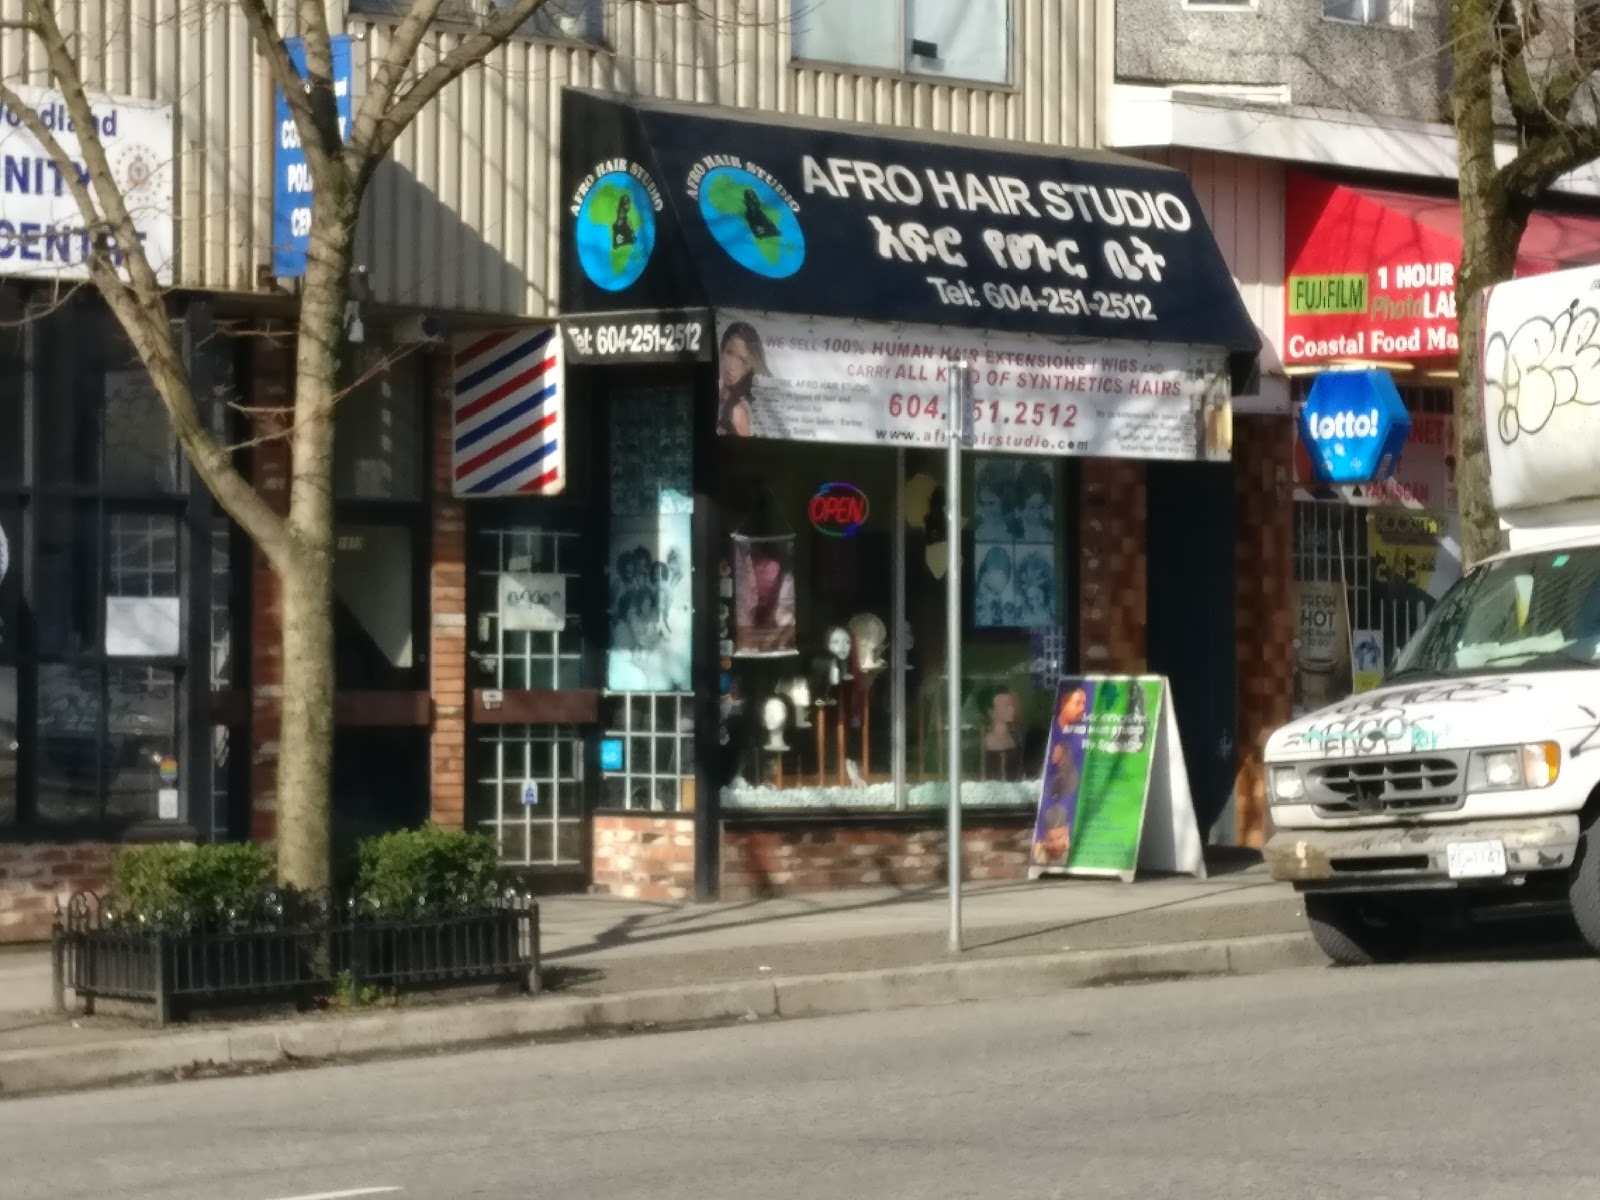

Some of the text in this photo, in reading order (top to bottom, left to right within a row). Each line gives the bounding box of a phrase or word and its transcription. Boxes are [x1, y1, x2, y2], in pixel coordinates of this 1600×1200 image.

[595, 157, 628, 178] HAIR
[702, 154, 742, 169] HAIR
[802, 155, 1192, 232] AFRO HAIR STUDIO
[1377, 262, 1455, 290] 1 HOUR
[926, 276, 1159, 322] Tel: 604-251-2512
[1295, 278, 1364, 310] FUJIFILM
[596, 322, 702, 355] 604-251-2512
[1288, 332, 1365, 358] Coastal
[1370, 326, 1421, 353] Food
[823, 338, 865, 355] 100%
[872, 341, 935, 360] HUMAN
[985, 350, 1086, 371] EXTENSIONS
[1101, 356, 1139, 374] WIGS
[895, 364, 928, 381] ALL
[936, 367, 980, 385] KD
[987, 369, 1011, 386] OF
[1016, 372, 1123, 393] SYNTHETICS
[1129, 378, 1182, 396] HAIRS
[888, 392, 1078, 428] 604.51.2512
[1309, 408, 1379, 440] lotto!
[809, 496, 863, 524] OPEN
[1300, 608, 1337, 629] HOT
